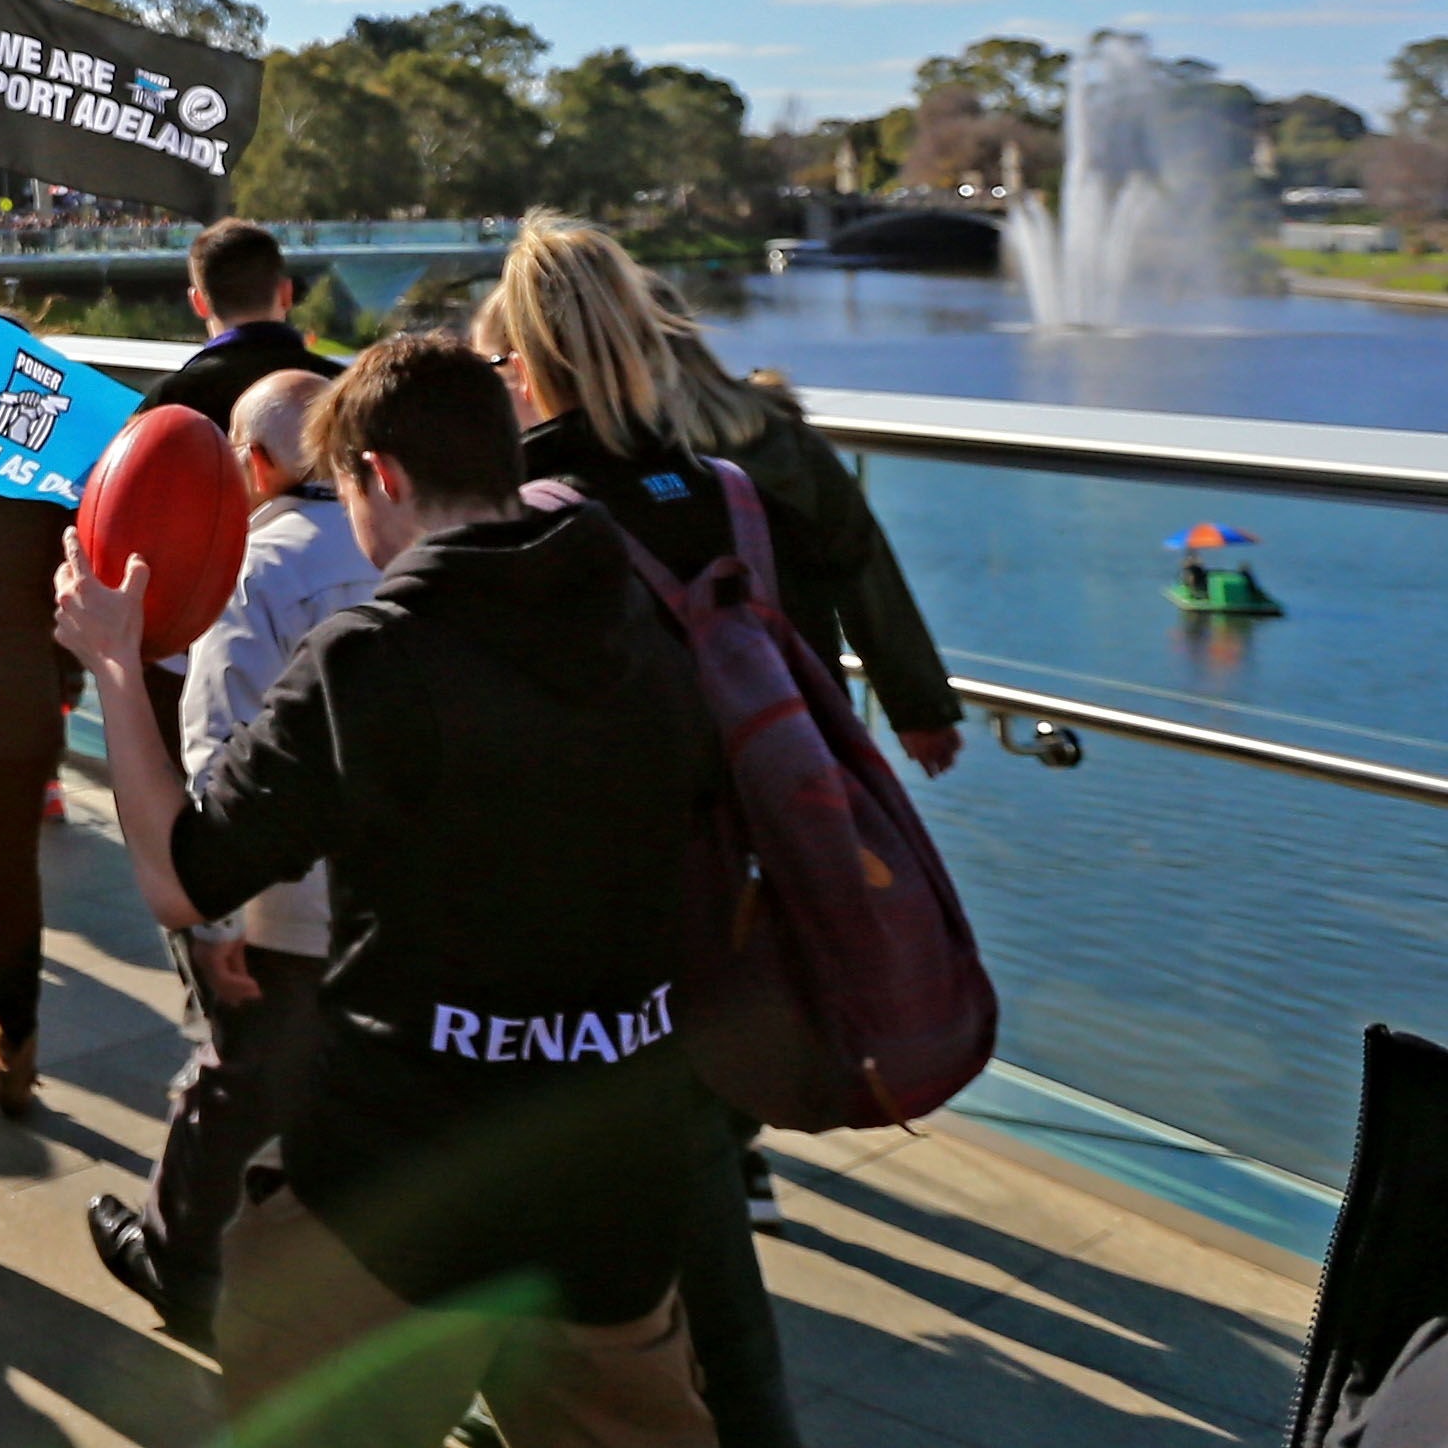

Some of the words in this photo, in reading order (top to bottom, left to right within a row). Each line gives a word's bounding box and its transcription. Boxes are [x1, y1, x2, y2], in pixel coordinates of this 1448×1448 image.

[48, 48, 116, 94] ARE
[135, 67, 171, 88] POWER
[16, 351, 62, 391] POWER
[431, 981, 672, 1063] RENAULT
